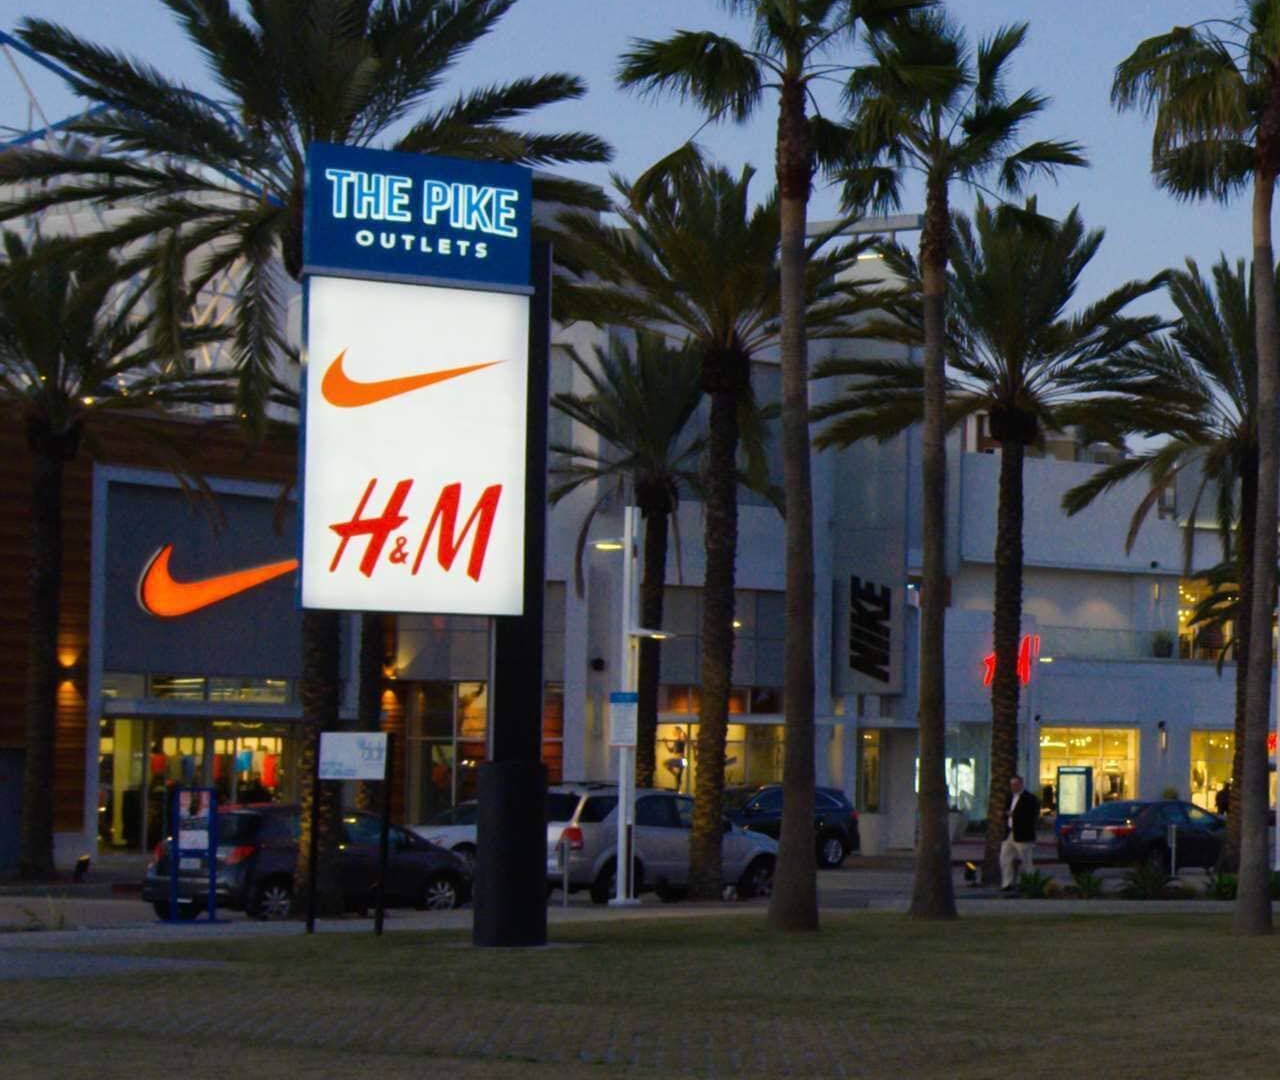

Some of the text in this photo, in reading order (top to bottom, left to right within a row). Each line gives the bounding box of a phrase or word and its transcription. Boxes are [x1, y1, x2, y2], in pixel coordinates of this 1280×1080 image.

[325, 169, 519, 237] THE PIKE
[355, 230, 488, 259] OUTLETS
[328, 478, 503, 583] H&M
[849, 574, 891, 684] NIKE
